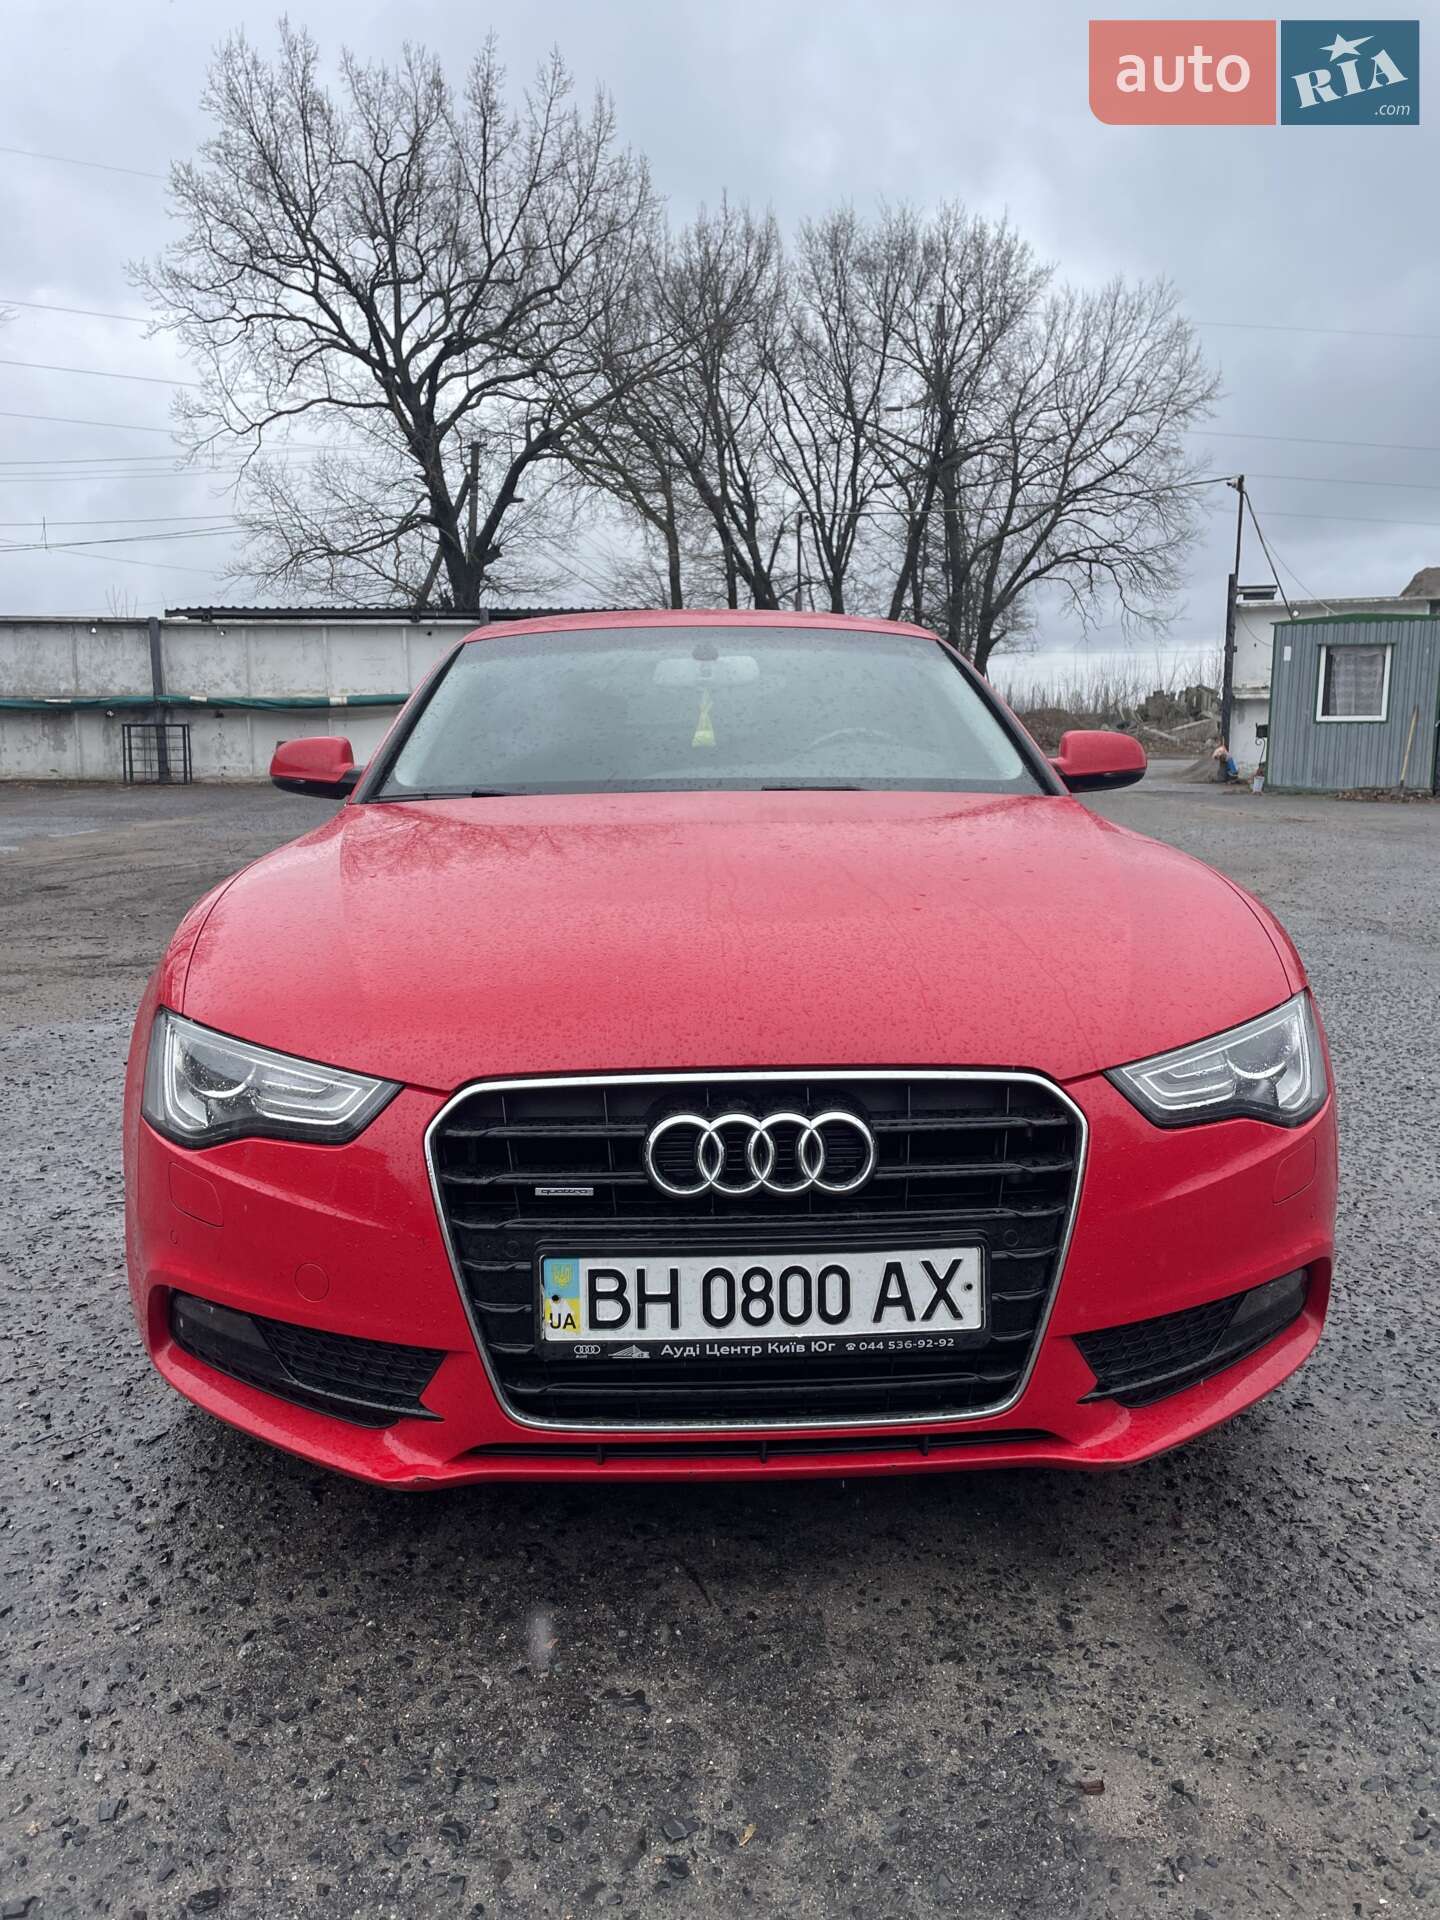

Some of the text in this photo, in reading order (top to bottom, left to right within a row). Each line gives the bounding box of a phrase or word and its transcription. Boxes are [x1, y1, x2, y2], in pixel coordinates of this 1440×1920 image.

[702, 1265, 851, 1328] 0800
[549, 1312, 576, 1329] UA
[661, 1338, 955, 1358] Ауді Центр Київ Юг 044 536-92-92
